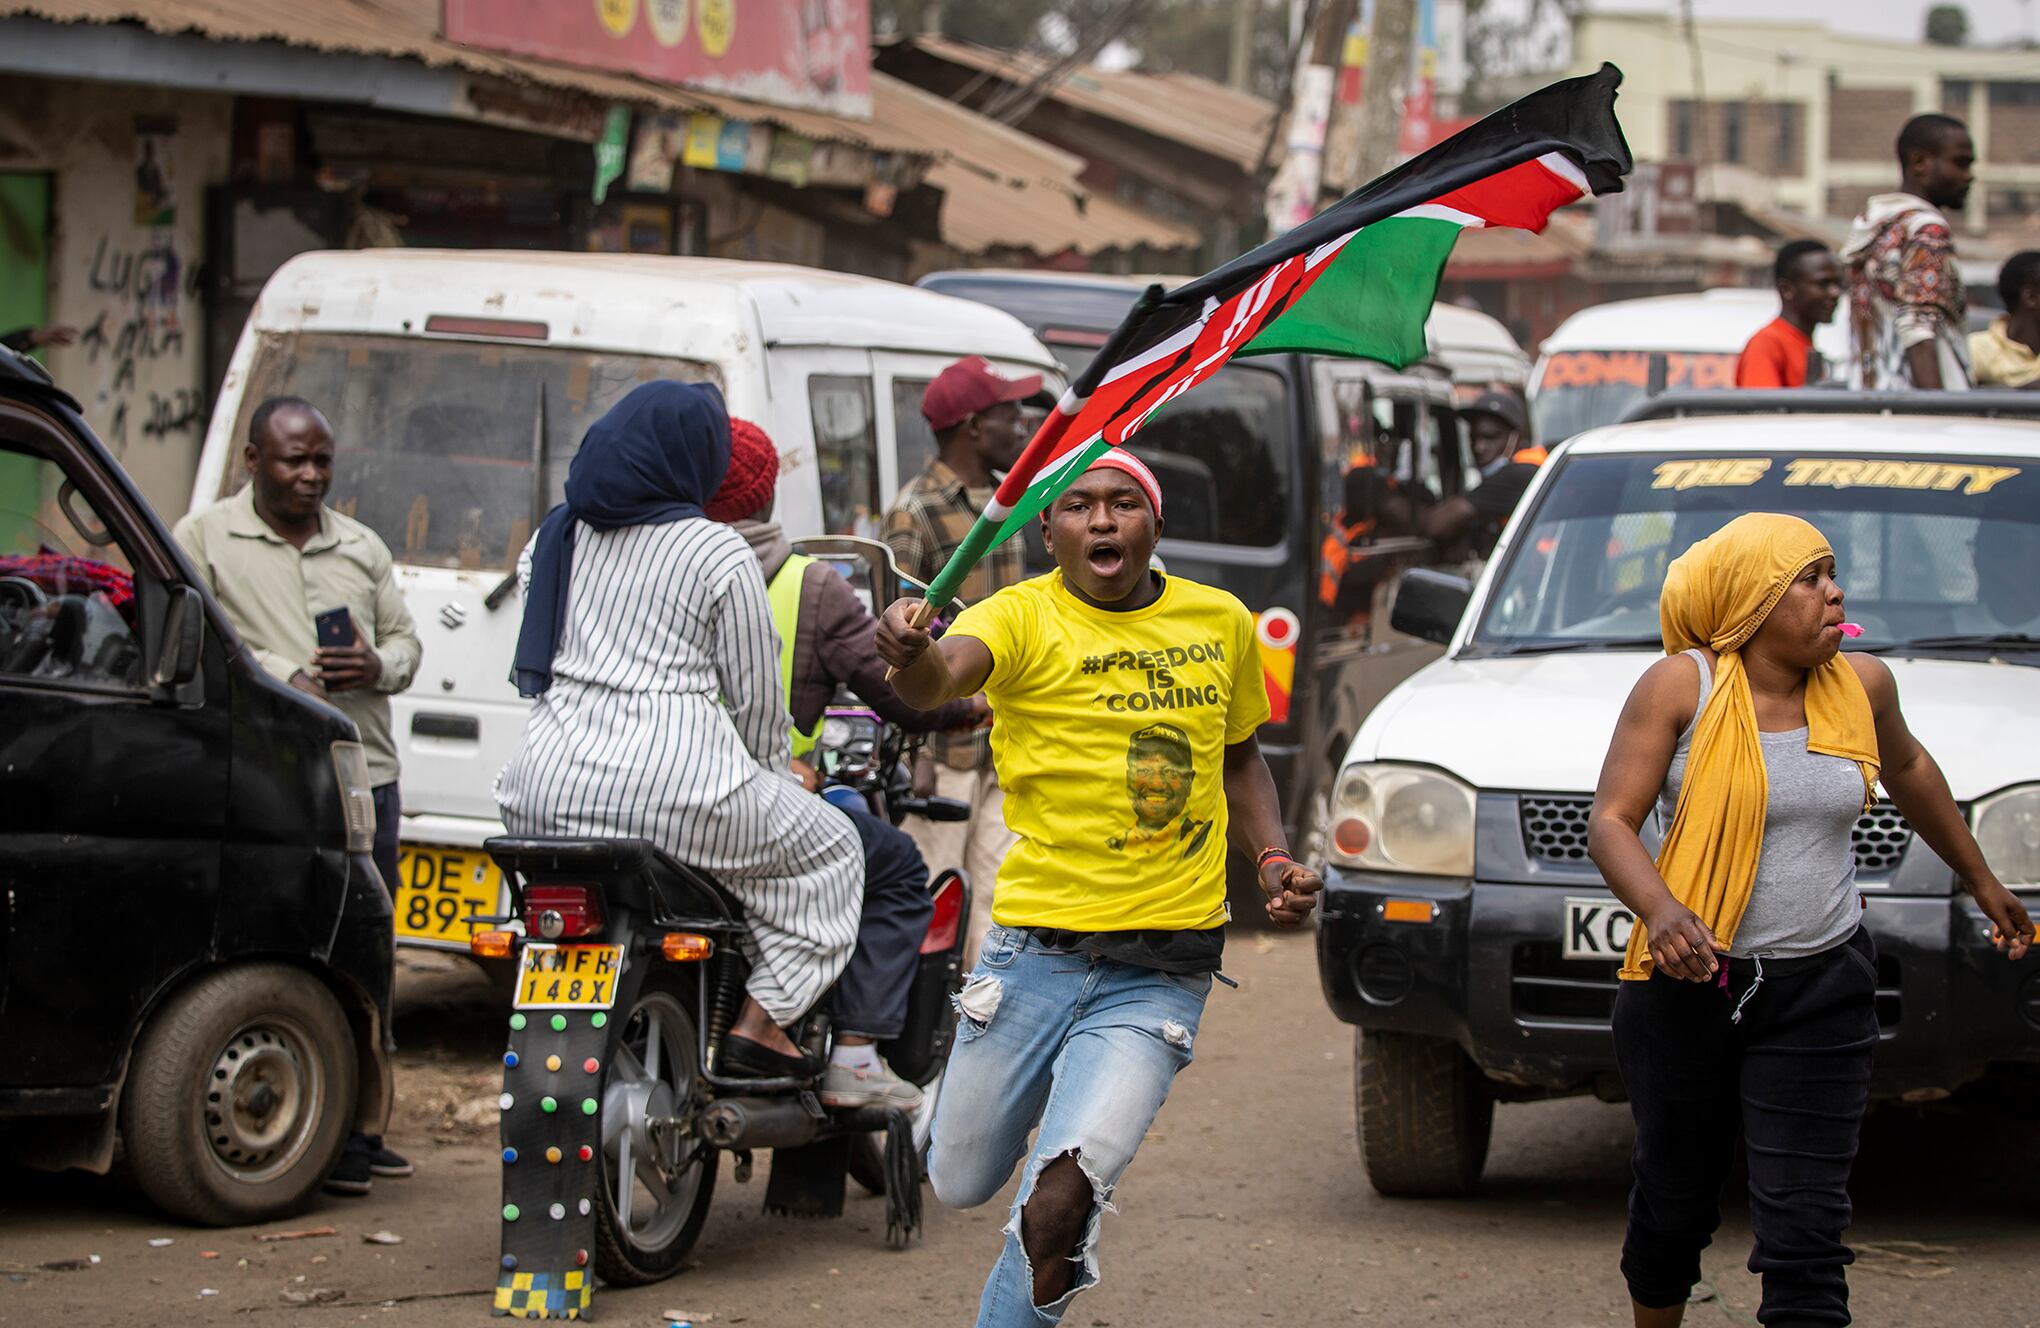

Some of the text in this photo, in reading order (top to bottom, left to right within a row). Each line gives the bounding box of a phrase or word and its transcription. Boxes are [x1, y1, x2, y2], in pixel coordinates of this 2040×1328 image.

[1650, 457, 2022, 495] THE TRINITY
[1081, 642, 1225, 675] #FREEDOM
[1146, 668, 1175, 690] IS
[1106, 684, 1218, 712] COMING
[1572, 906, 1635, 952] KC
[529, 947, 615, 975] KMFH
[527, 979, 606, 1004] 148X
